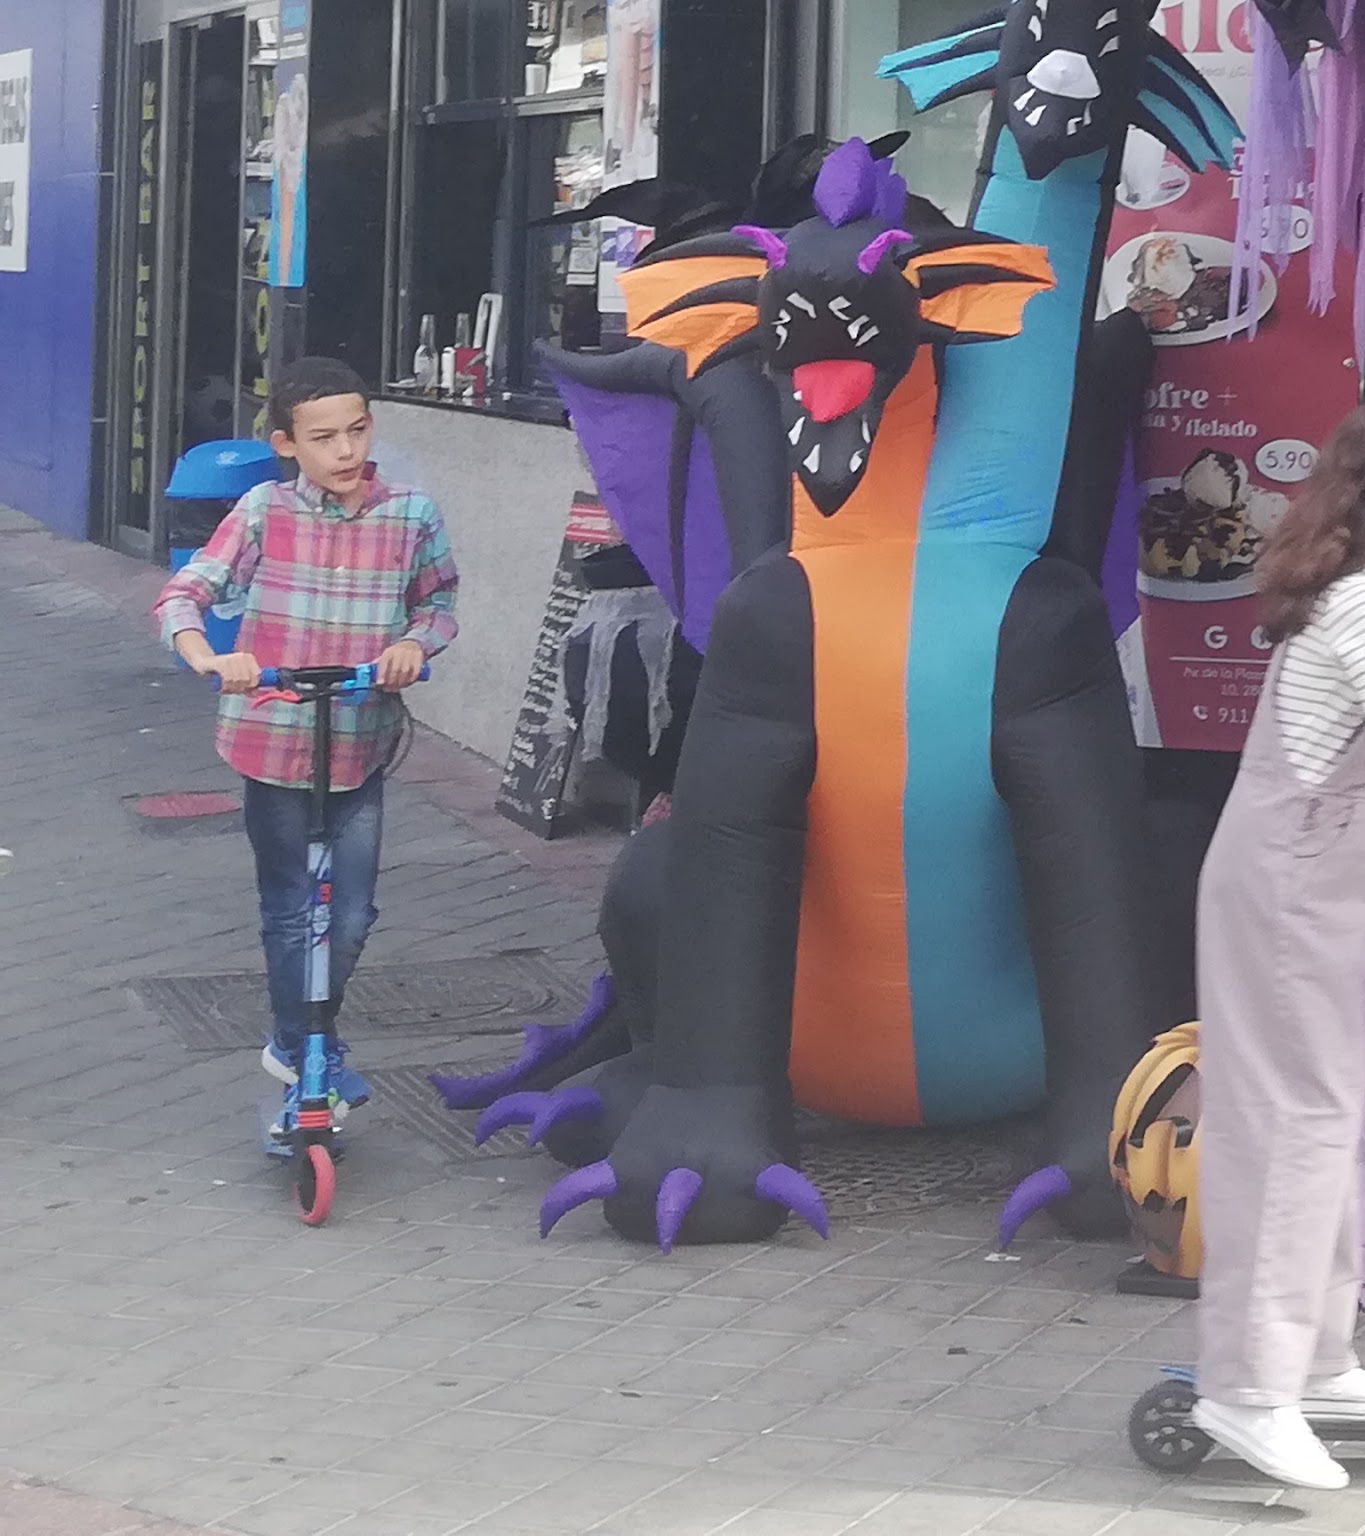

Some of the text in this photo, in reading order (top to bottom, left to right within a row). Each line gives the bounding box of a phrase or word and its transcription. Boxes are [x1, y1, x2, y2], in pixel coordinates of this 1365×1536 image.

[1144, 381, 1210, 410] ofre
[1263, 450, 1313, 470] 5.90
[1217, 706, 1249, 724] 911
